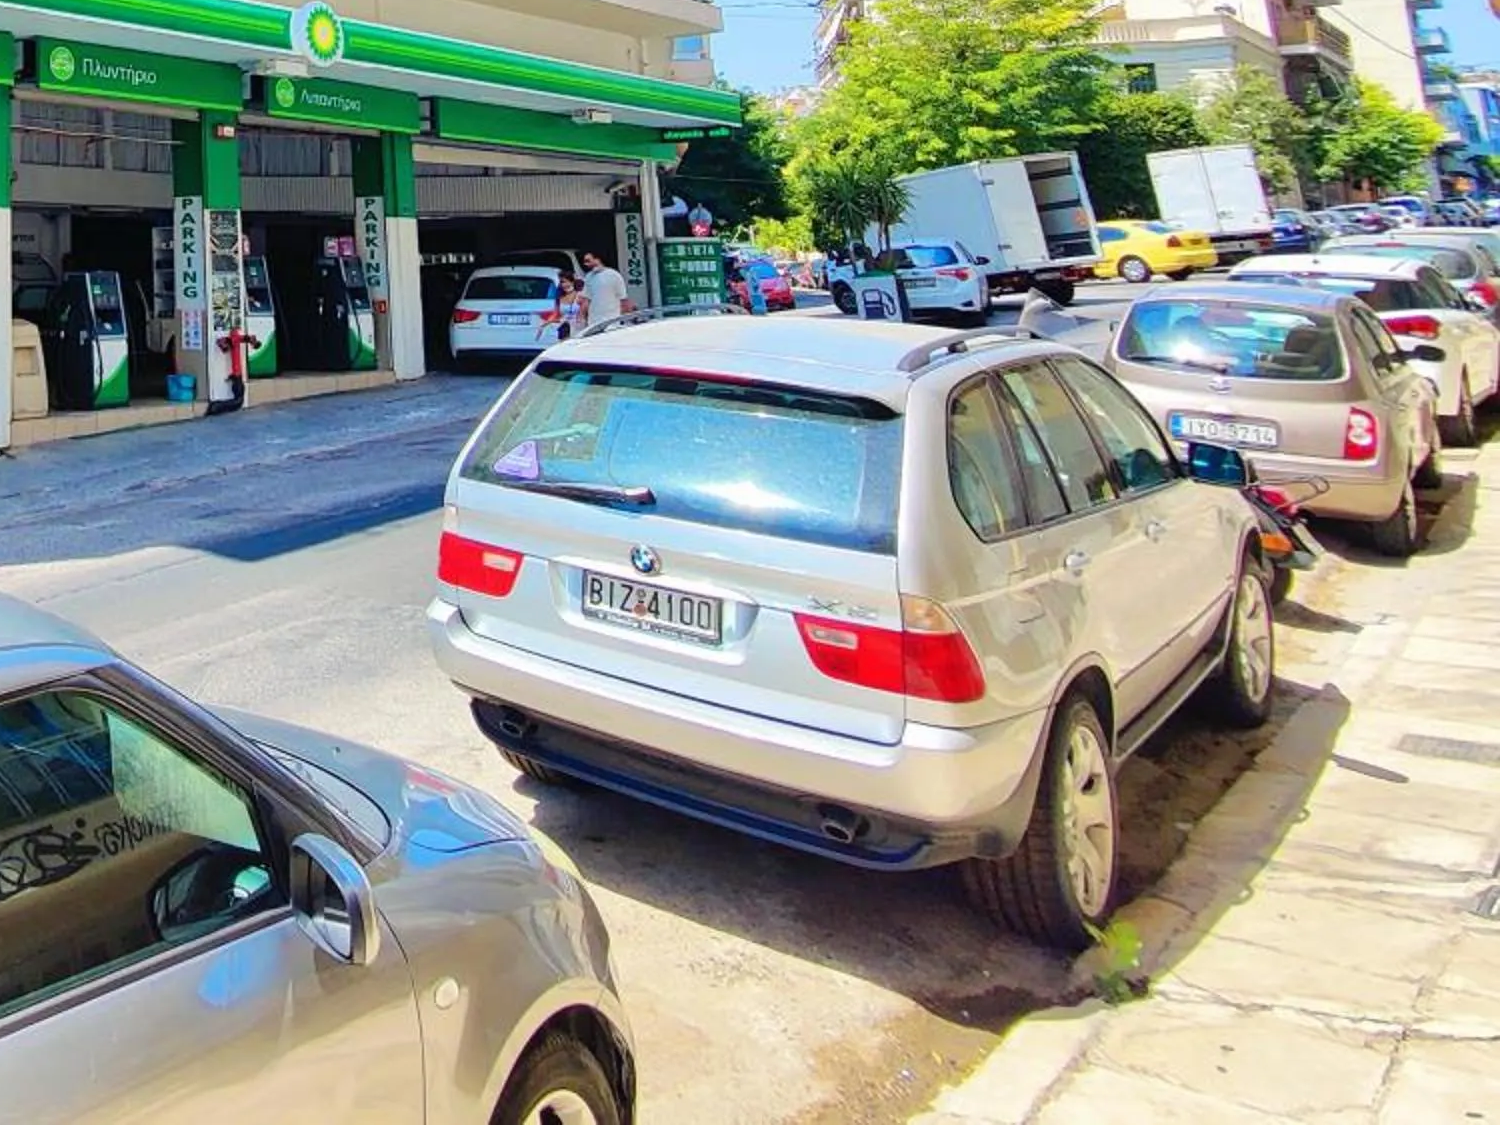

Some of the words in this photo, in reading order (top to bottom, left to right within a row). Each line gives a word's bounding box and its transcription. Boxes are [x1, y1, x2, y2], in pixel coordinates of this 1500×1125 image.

[83, 58, 157, 86] Πλυντήριο
[180, 198, 198, 299] PARKING
[363, 198, 381, 287] PARKING
